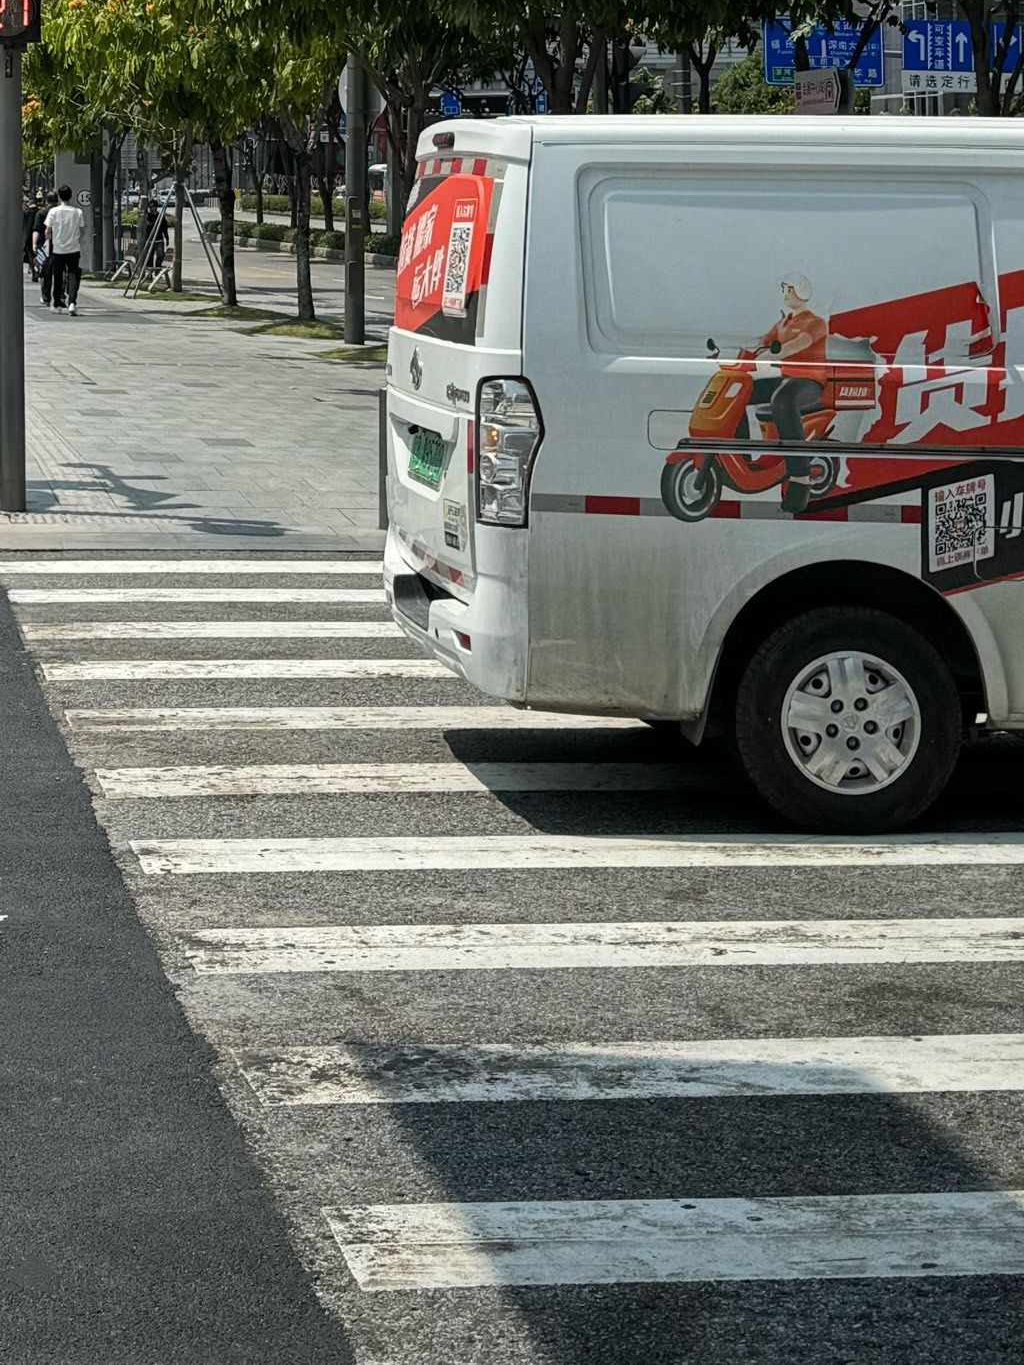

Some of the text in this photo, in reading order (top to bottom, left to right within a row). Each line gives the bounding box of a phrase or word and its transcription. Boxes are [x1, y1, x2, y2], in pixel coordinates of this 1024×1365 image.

[934, 24, 945, 70] 可变车道
[909, 75, 977, 89] 请选定行
